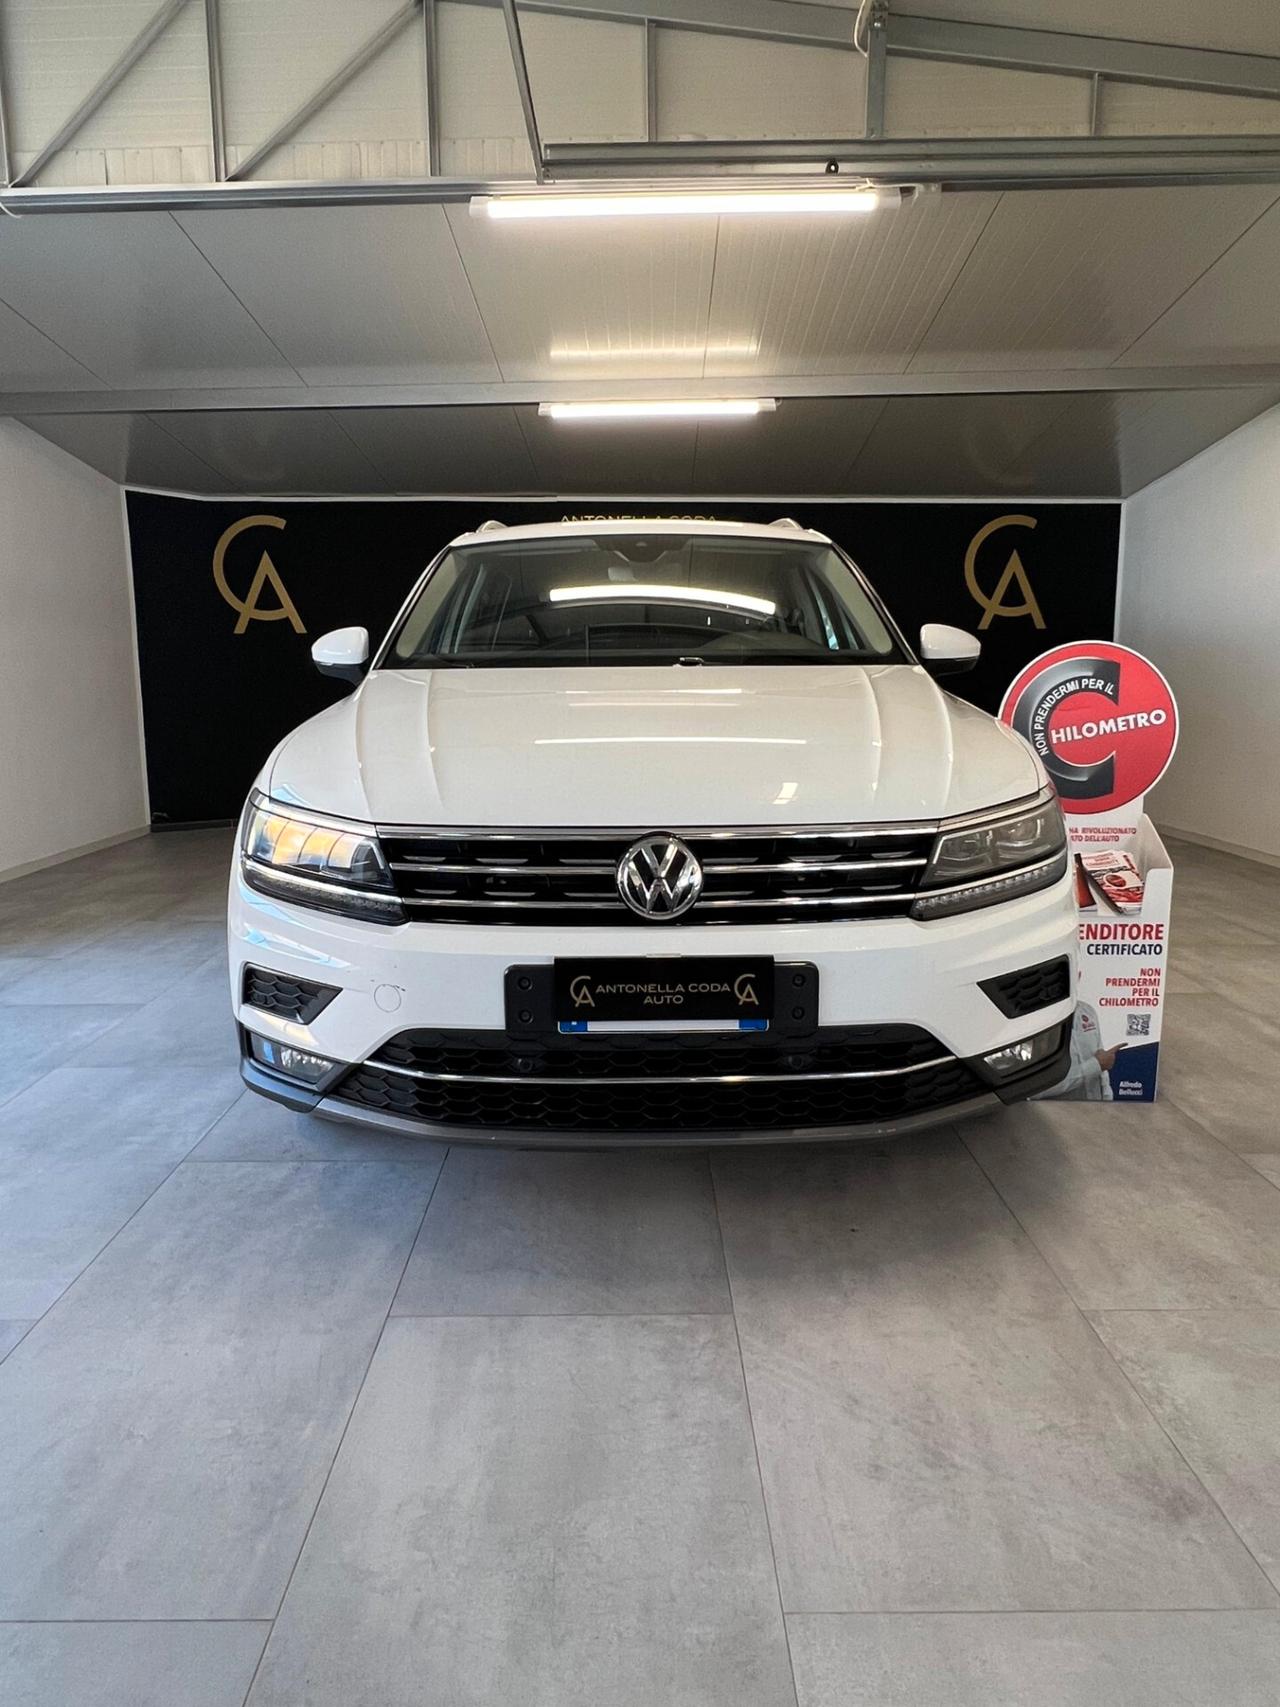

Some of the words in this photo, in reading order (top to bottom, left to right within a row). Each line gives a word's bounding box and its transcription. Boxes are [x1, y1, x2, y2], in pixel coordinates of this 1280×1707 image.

[1081, 677, 1105, 691] PER
[1104, 682, 1115, 696] IL
[1033, 679, 1080, 731] PRENDERMI
[1033, 732, 1050, 757] NON
[1086, 943, 1163, 956] CERTIFICATO
[1140, 968, 1161, 977] NON
[595, 983, 685, 993] ANTONELLA
[688, 982, 731, 993] CODA
[1105, 977, 1161, 987] PRENDERMI
[1132, 988, 1150, 997] PER
[1151, 988, 1160, 997] IL
[643, 994, 685, 1005] AUTO
[1099, 997, 1159, 1007] CHILOMETRO
